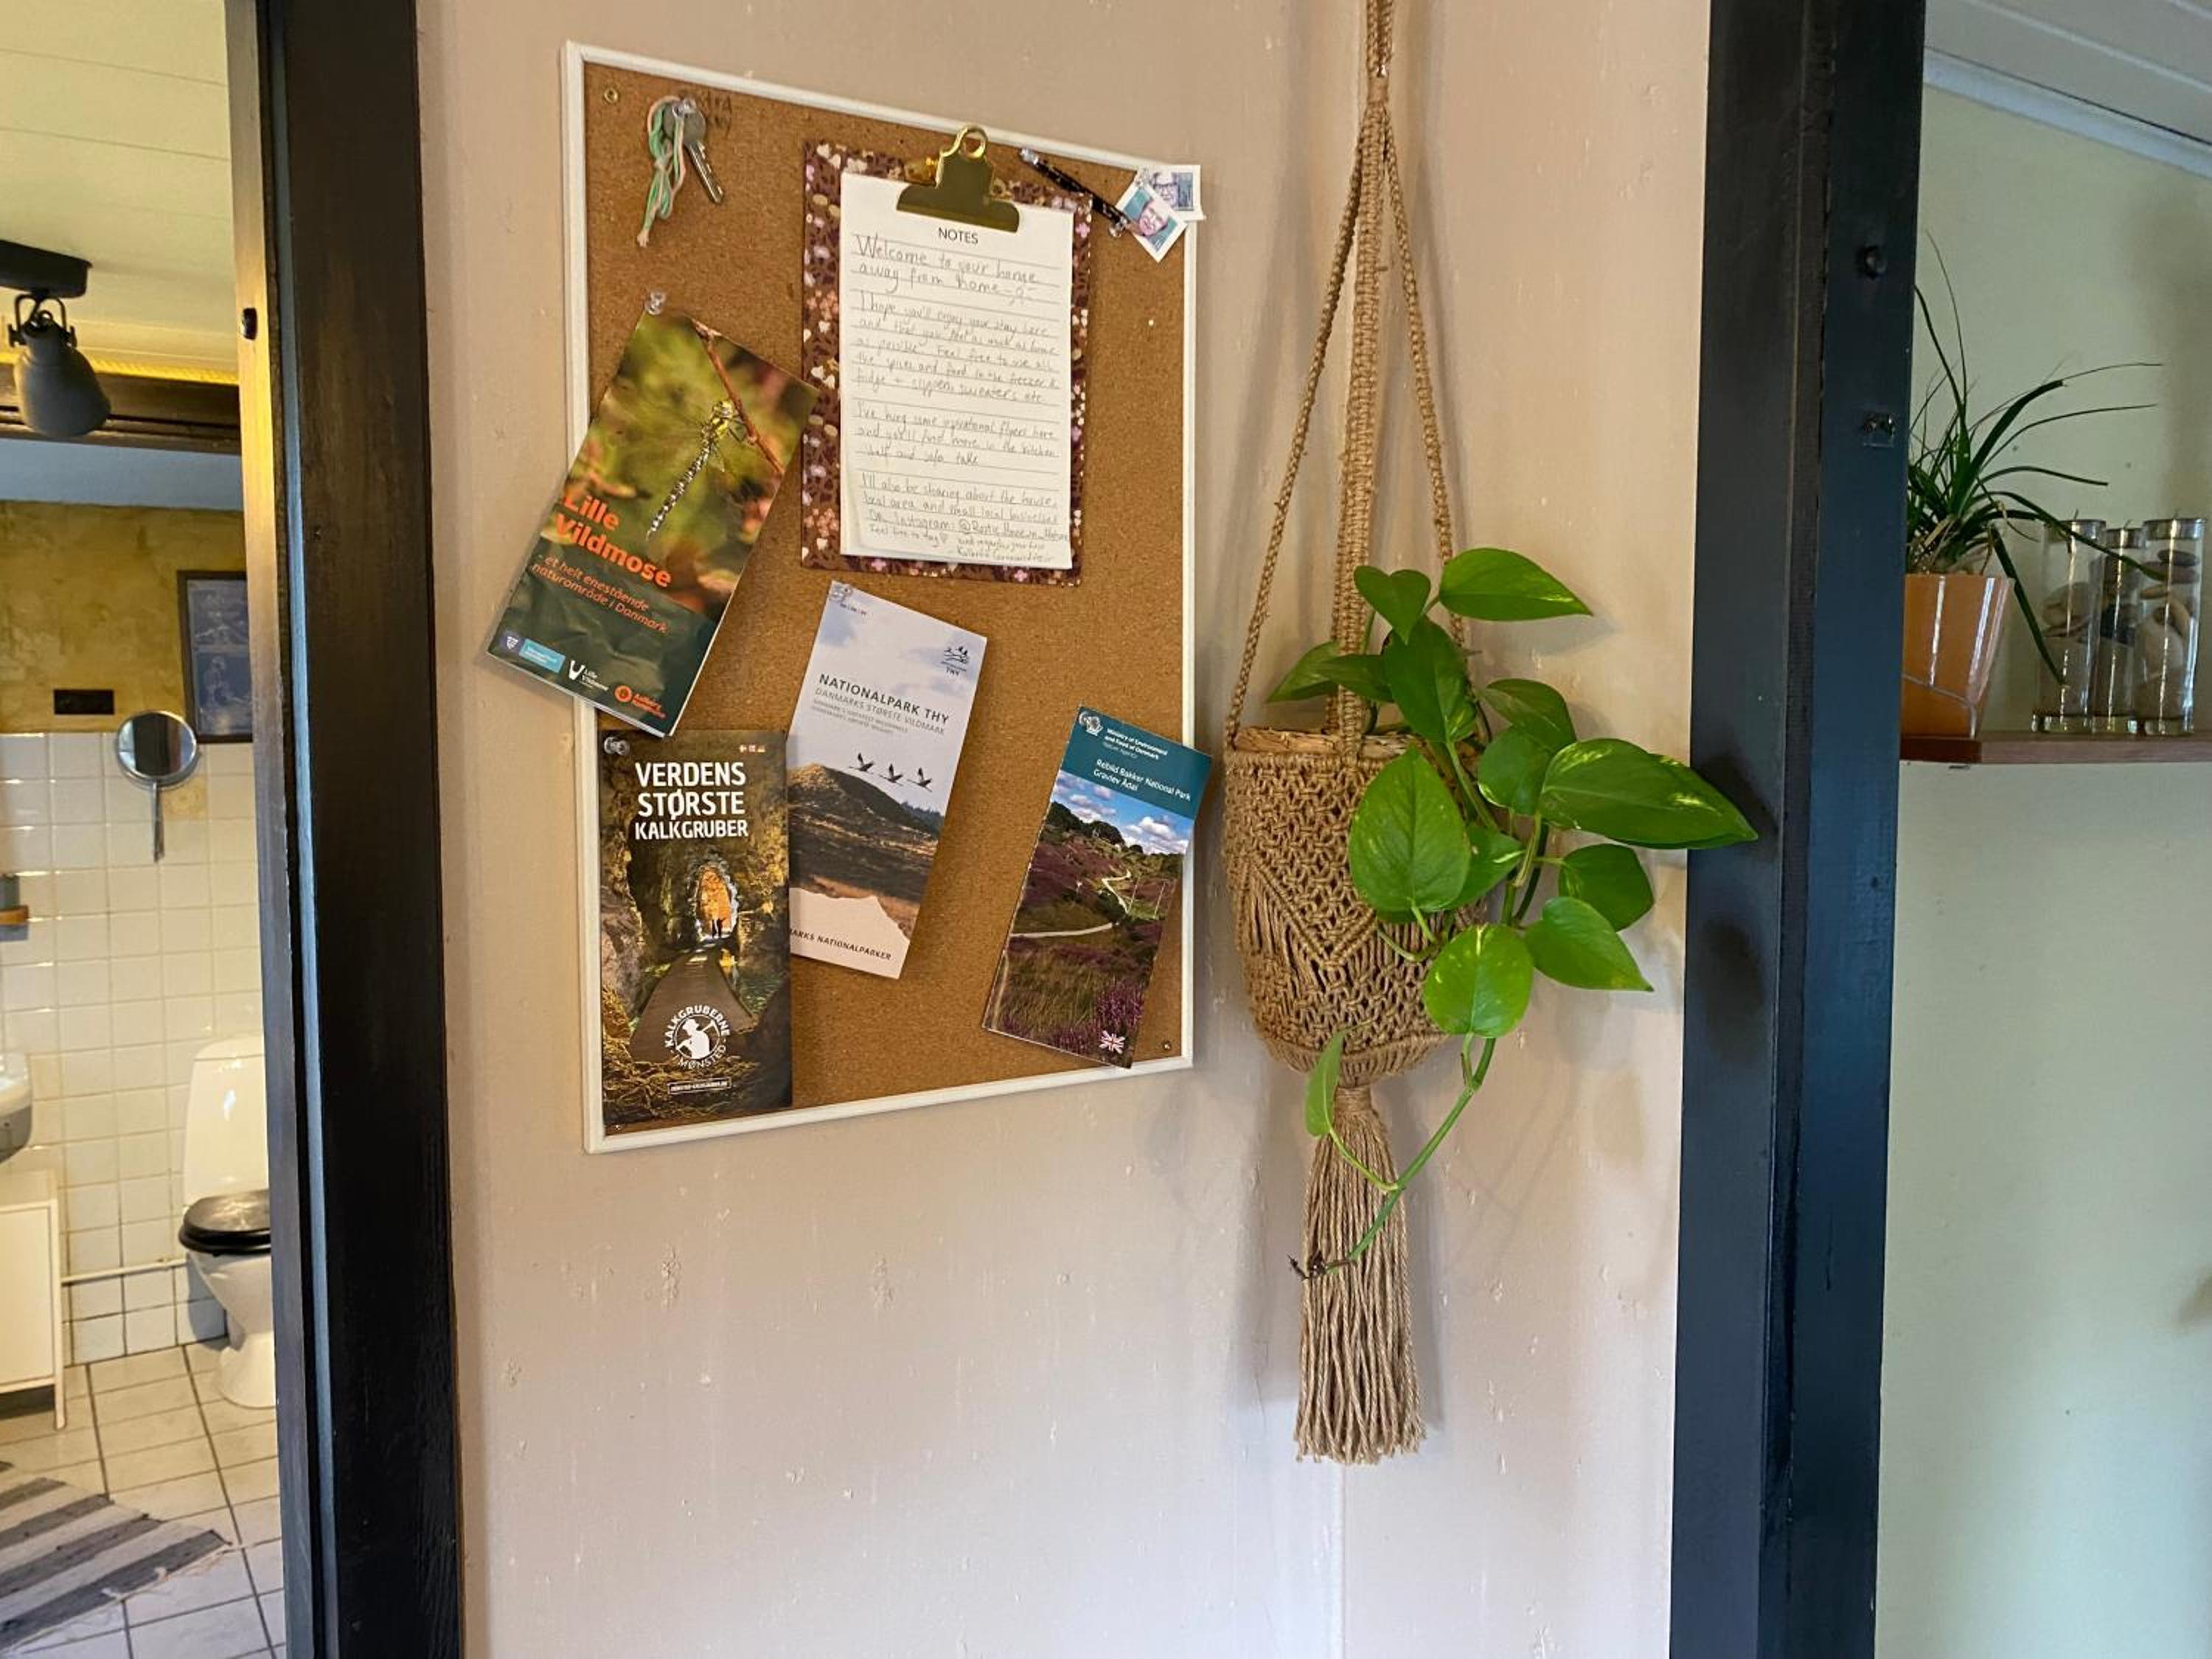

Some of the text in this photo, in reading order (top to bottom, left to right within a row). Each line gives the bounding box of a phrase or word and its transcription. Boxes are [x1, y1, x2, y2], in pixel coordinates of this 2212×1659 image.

[855, 232, 928, 265] Welcome
[938, 253, 951, 268] to
[938, 227, 978, 245] NOTES
[860, 262, 899, 293] away
[910, 266, 942, 290] from
[563, 495, 619, 531] Lille
[555, 513, 672, 588] Vildmose
[532, 563, 609, 605] naturområde
[615, 602, 669, 634] Danmark
[544, 557, 649, 611] et helt enestående
[815, 687, 865, 712] DANMARKS
[866, 704, 902, 722] STØRSTE
[905, 715, 945, 735] VILDMARK
[818, 672, 920, 716] NATIONALPARK
[925, 707, 950, 725] THY
[635, 762, 746, 787] VERDENS
[1119, 768, 1145, 782] Bakker
[1145, 778, 1175, 795] National
[1175, 788, 1191, 801] Park
[638, 788, 745, 821] STØRSTE
[635, 819, 748, 840] KALKGRUBER
[790, 928, 891, 960] ARKS NATIONALPARKER
[664, 1004, 730, 1048] KALKGRUBERNE
